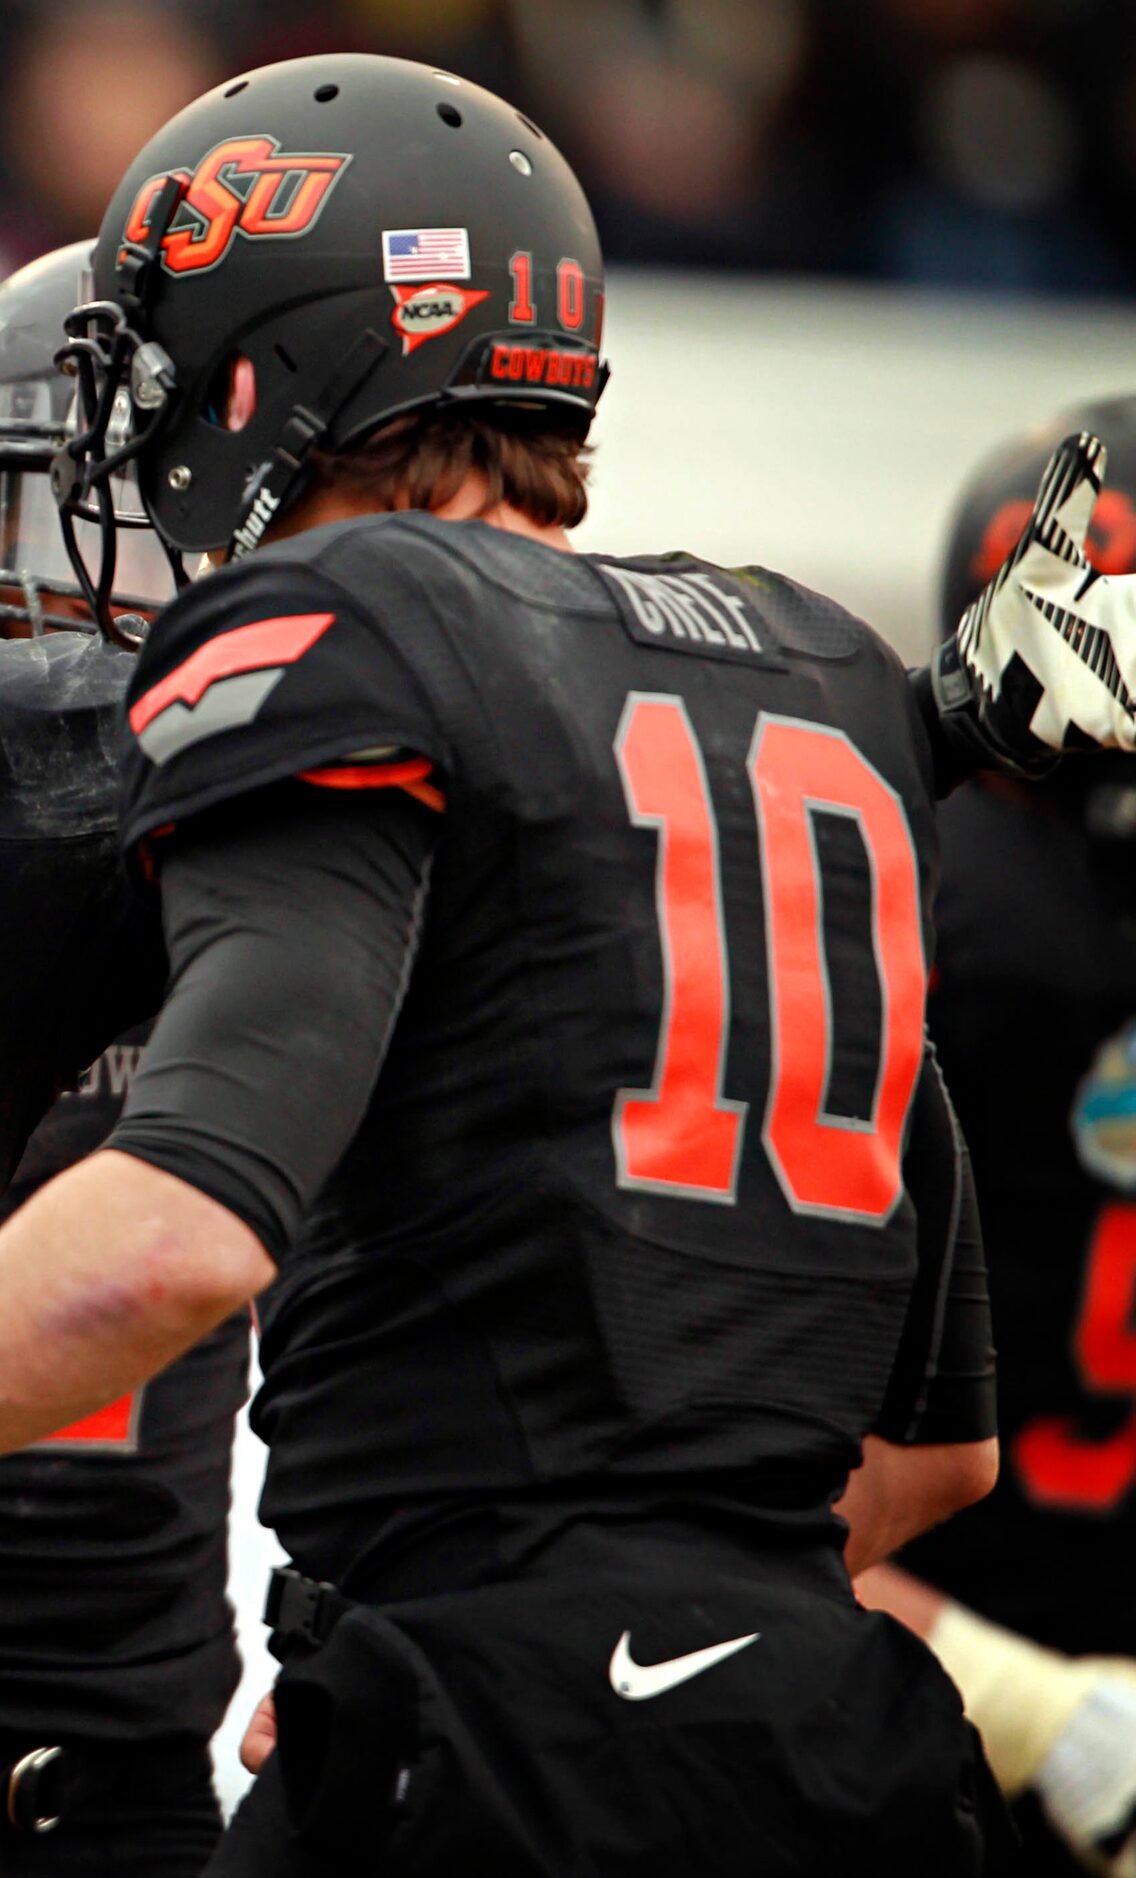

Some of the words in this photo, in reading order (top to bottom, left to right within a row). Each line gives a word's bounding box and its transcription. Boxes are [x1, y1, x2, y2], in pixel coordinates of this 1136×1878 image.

[117, 133, 354, 279] OSU
[401, 301, 456, 320] NCAA
[509, 250, 585, 332] 10
[490, 343, 597, 388] COWBOYS
[232, 487, 281, 563] chutt
[613, 690, 927, 1228] 10
